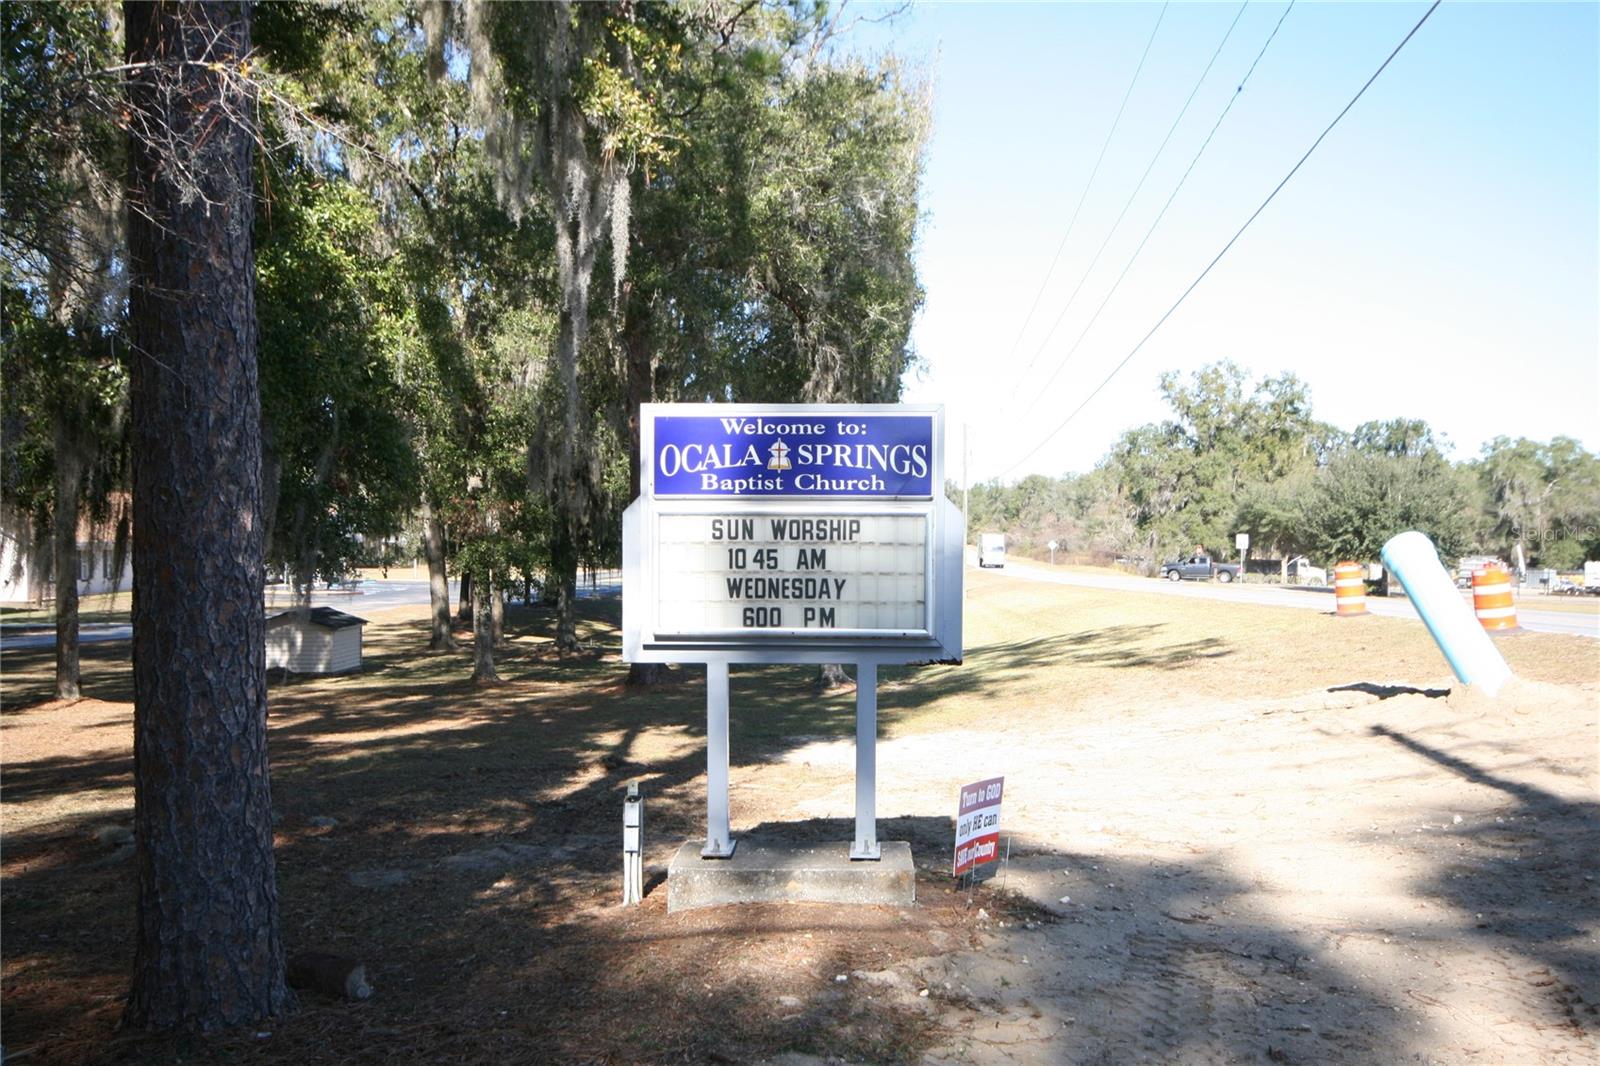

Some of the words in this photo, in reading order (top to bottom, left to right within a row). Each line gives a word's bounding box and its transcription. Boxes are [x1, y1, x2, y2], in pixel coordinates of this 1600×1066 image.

[720, 418, 826, 436] Welcome
[837, 420, 867, 436] to:
[659, 443, 763, 477] OCALA
[797, 443, 927, 479] SPRINGS
[700, 473, 784, 493] Baptist
[794, 473, 886, 492] Church
[711, 519, 754, 541] SUN
[771, 519, 861, 541] WORSHIP
[796, 548, 826, 570] AM
[726, 577, 846, 600] WEDNESDAY
[742, 607, 782, 628] 600
[803, 607, 836, 628] PM
[962, 791, 977, 808] Turn
[977, 788, 985, 803] to
[986, 783, 1000, 800] GOD
[959, 818, 972, 837] only
[972, 813, 983, 832] HE
[983, 813, 997, 828] can
[974, 841, 995, 857] Country
